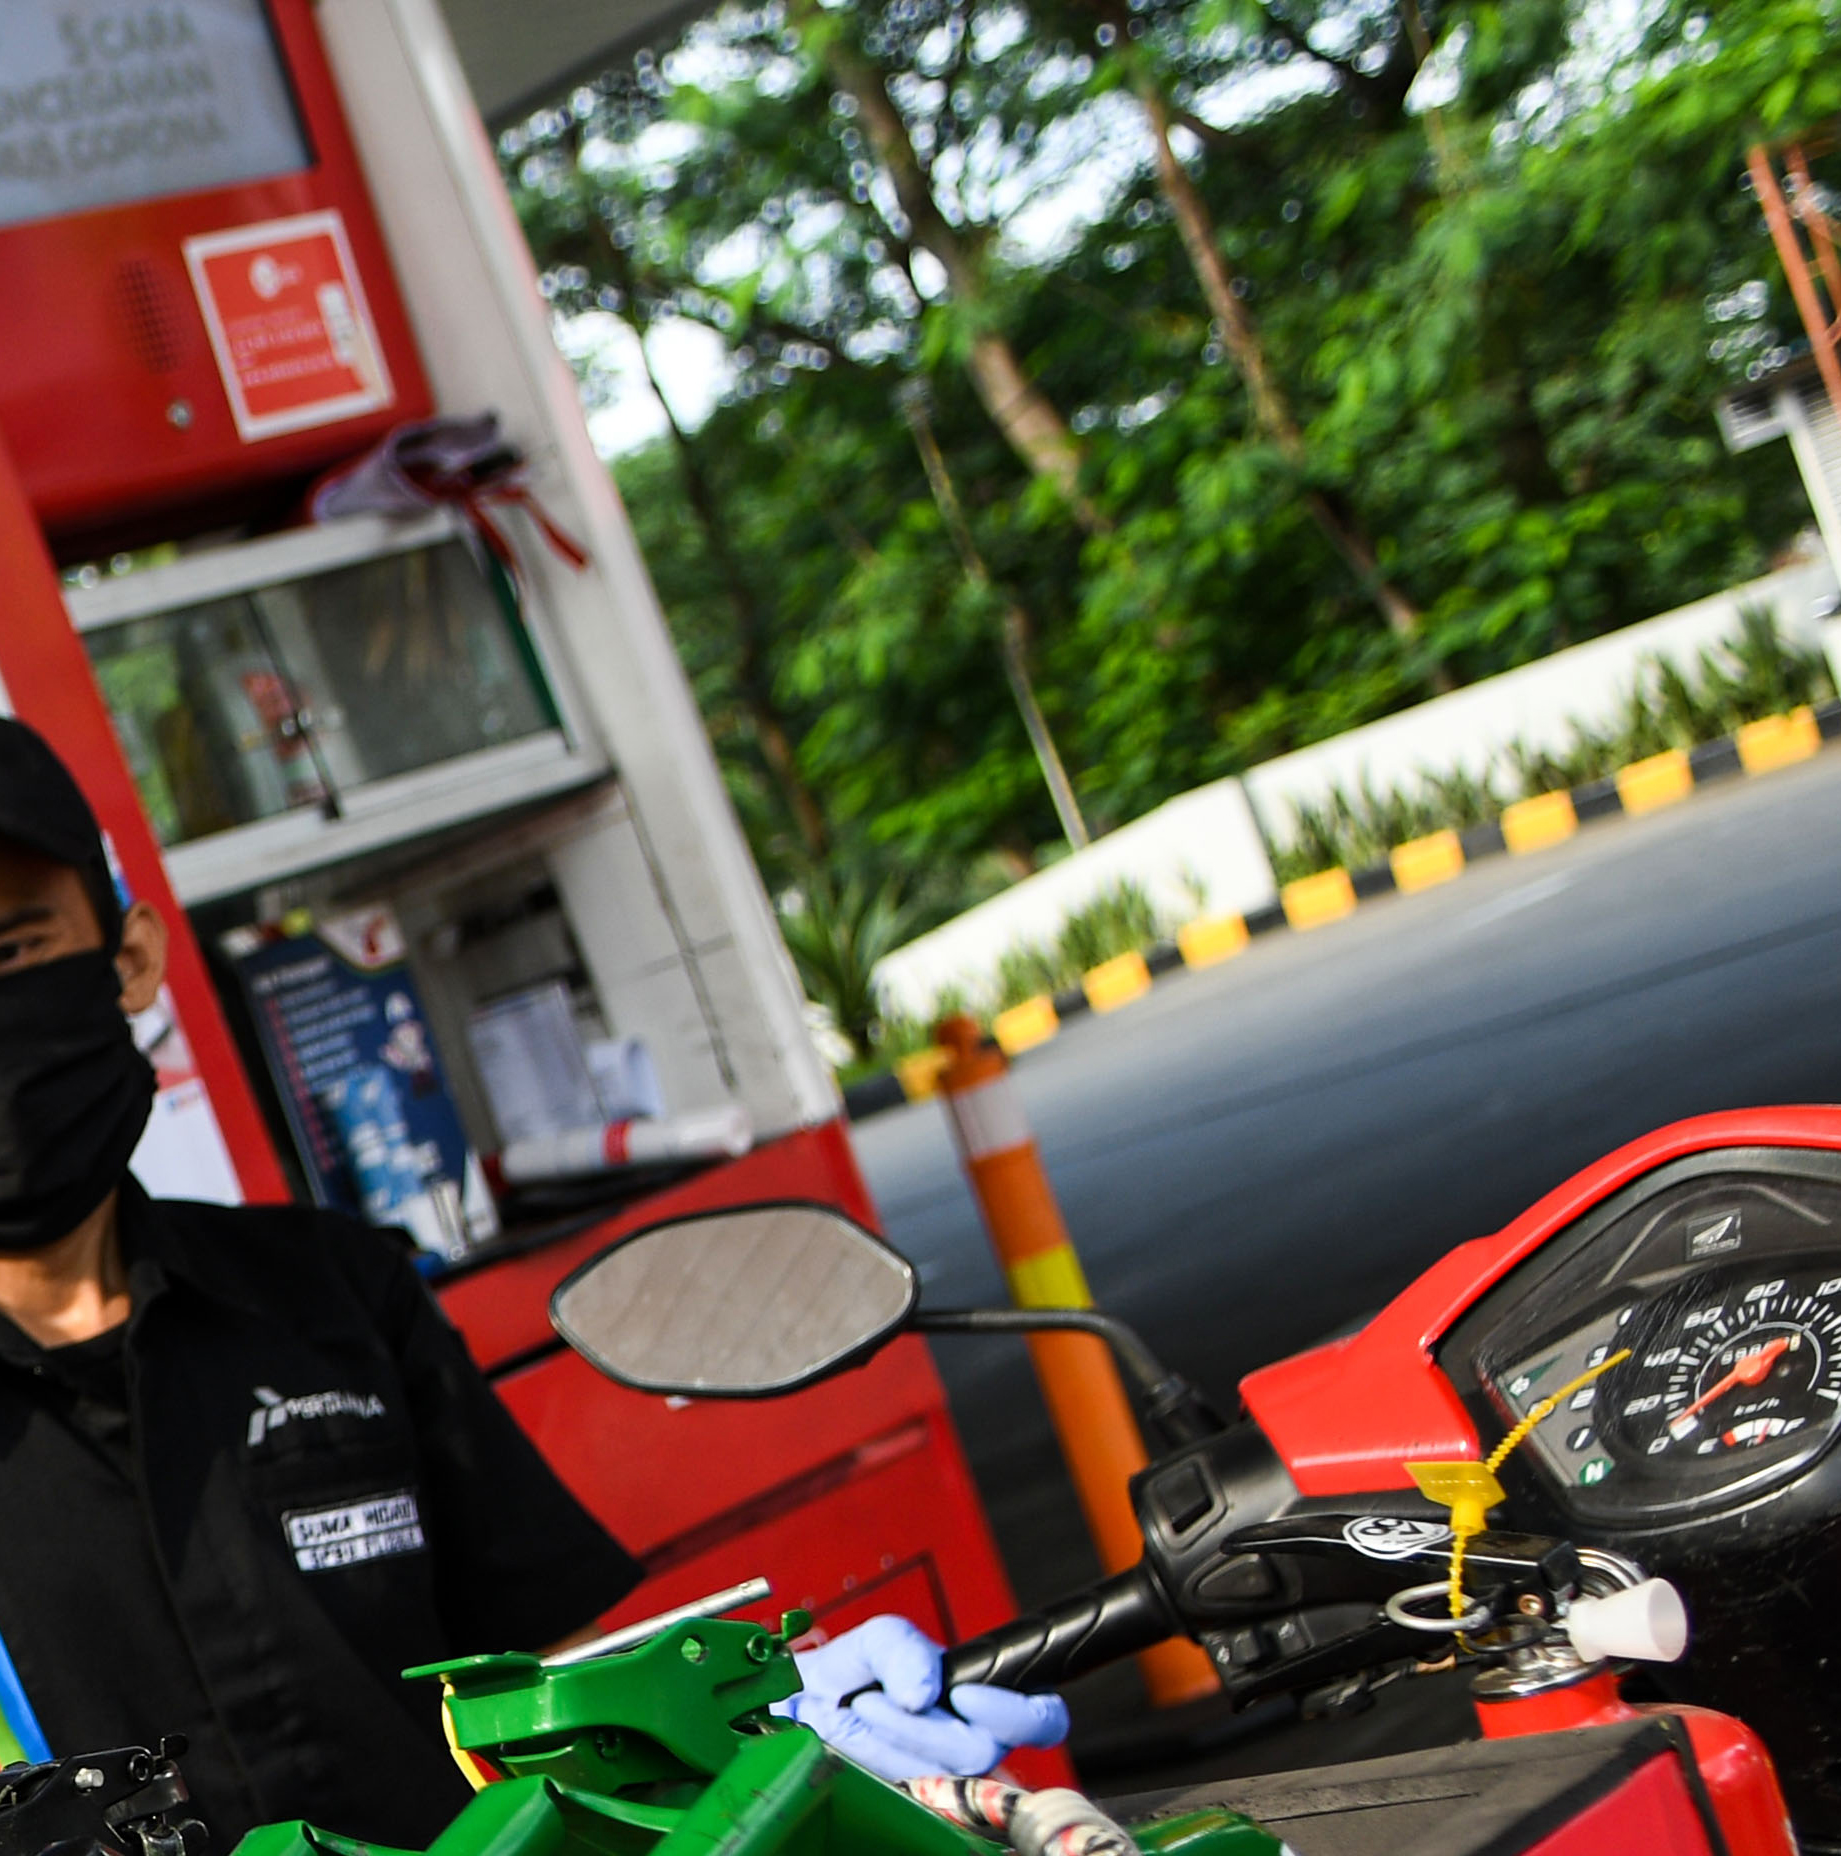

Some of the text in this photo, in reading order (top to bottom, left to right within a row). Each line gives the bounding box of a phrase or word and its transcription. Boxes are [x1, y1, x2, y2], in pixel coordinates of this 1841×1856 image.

[1683, 1305, 1724, 1331] 60
[1642, 1346, 1682, 1369] 40
[1623, 1393, 1663, 1417] 20
[1733, 1397, 1781, 1418] km/h
[1584, 1460, 1605, 1484] N
